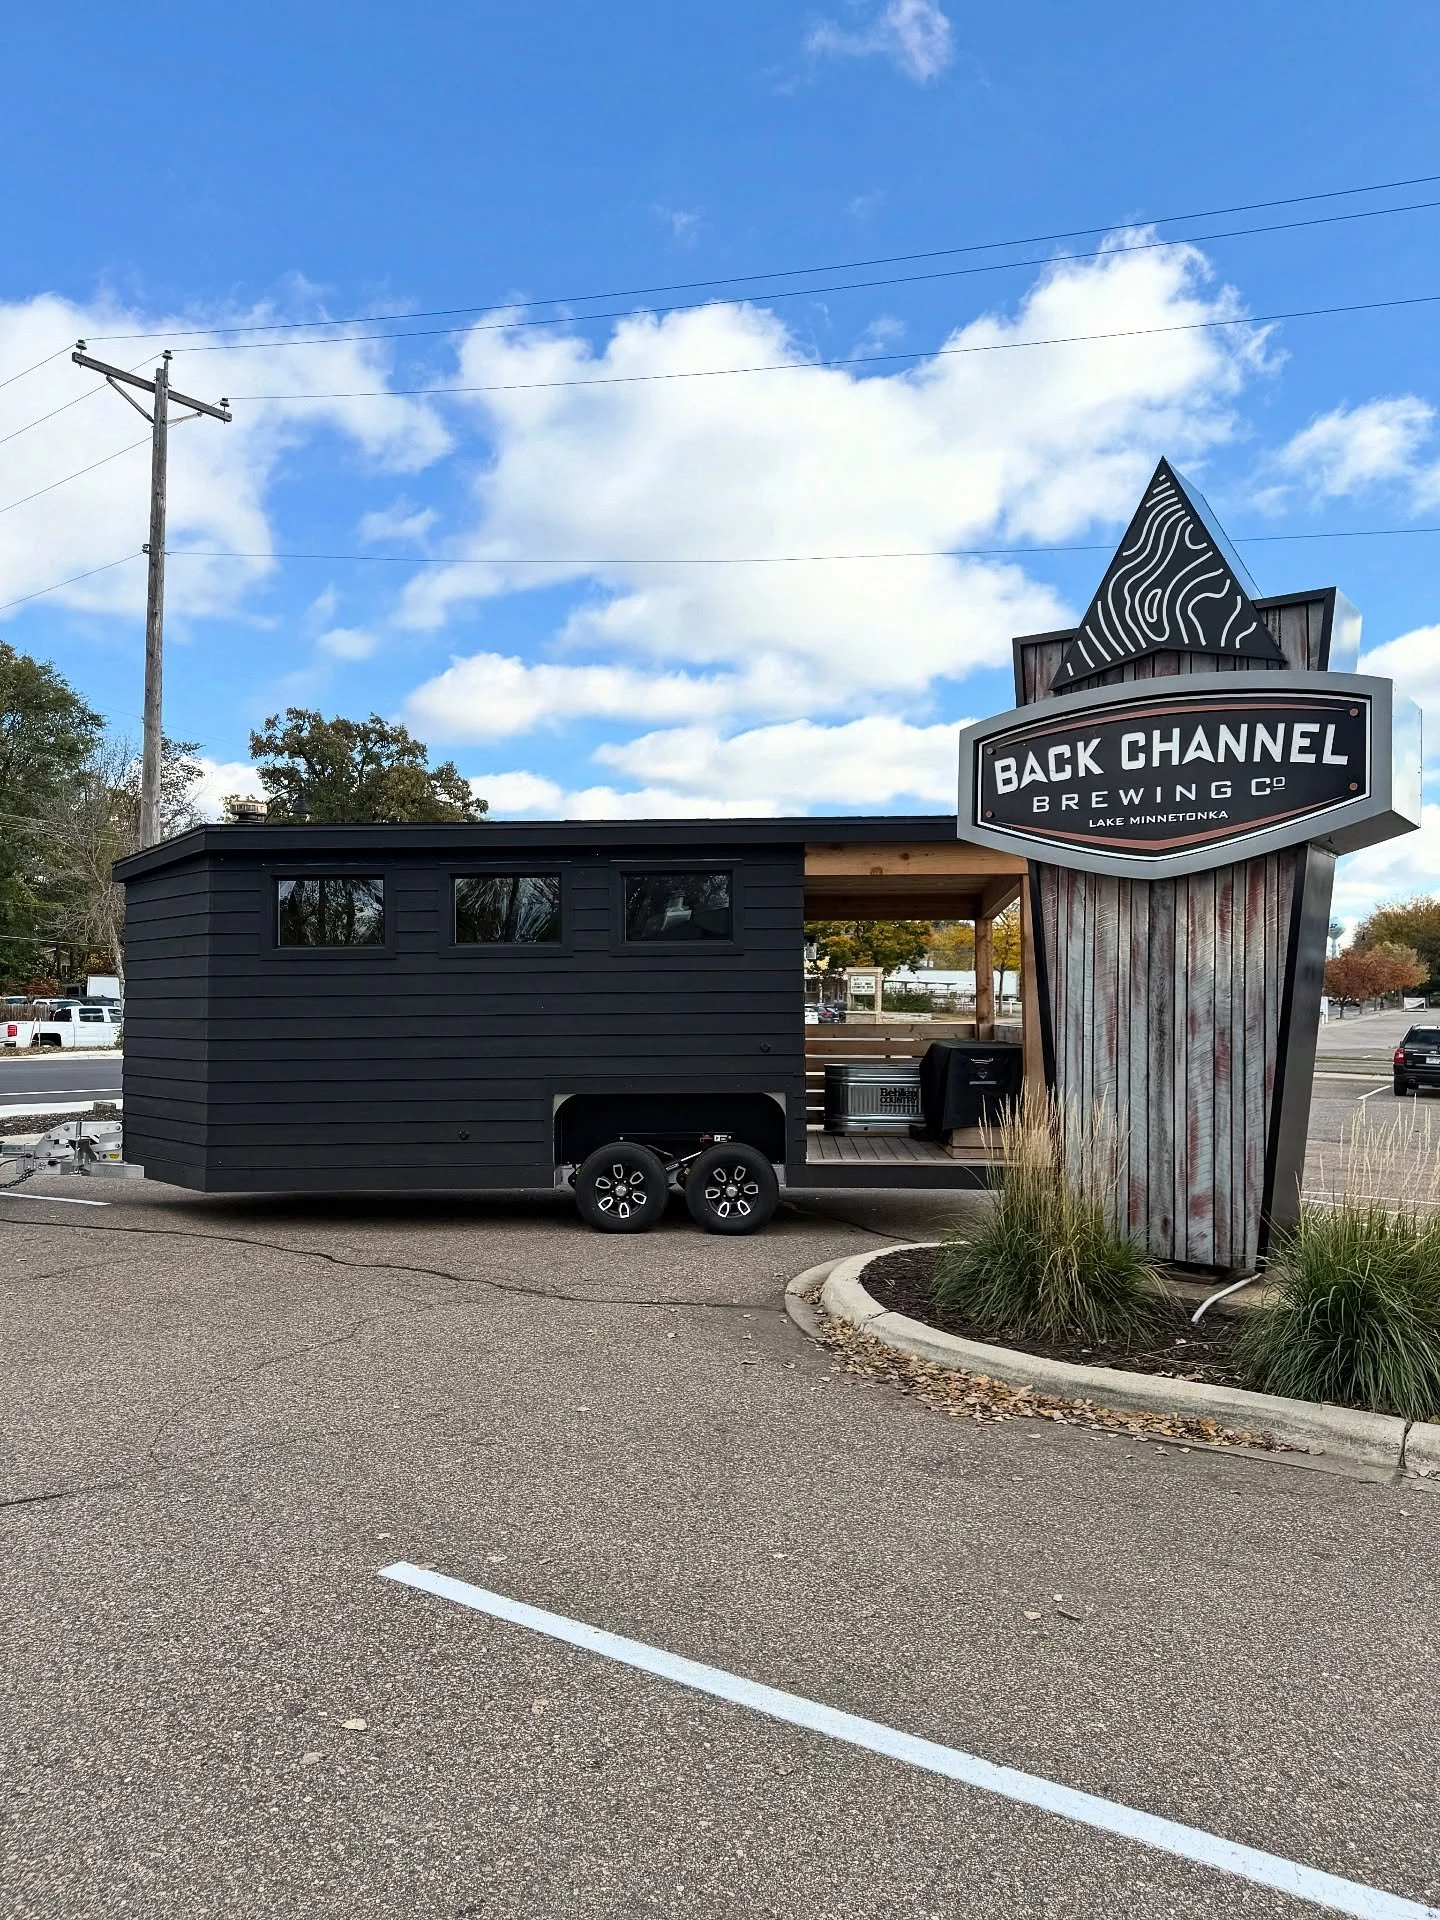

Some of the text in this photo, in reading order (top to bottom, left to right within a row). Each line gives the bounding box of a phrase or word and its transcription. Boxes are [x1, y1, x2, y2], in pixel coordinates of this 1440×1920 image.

[994, 723, 1349, 795] BACK CHANNEL
[1032, 780, 1233, 813] BREWING
[1089, 810, 1229, 828] LAKE MINNETONKA
